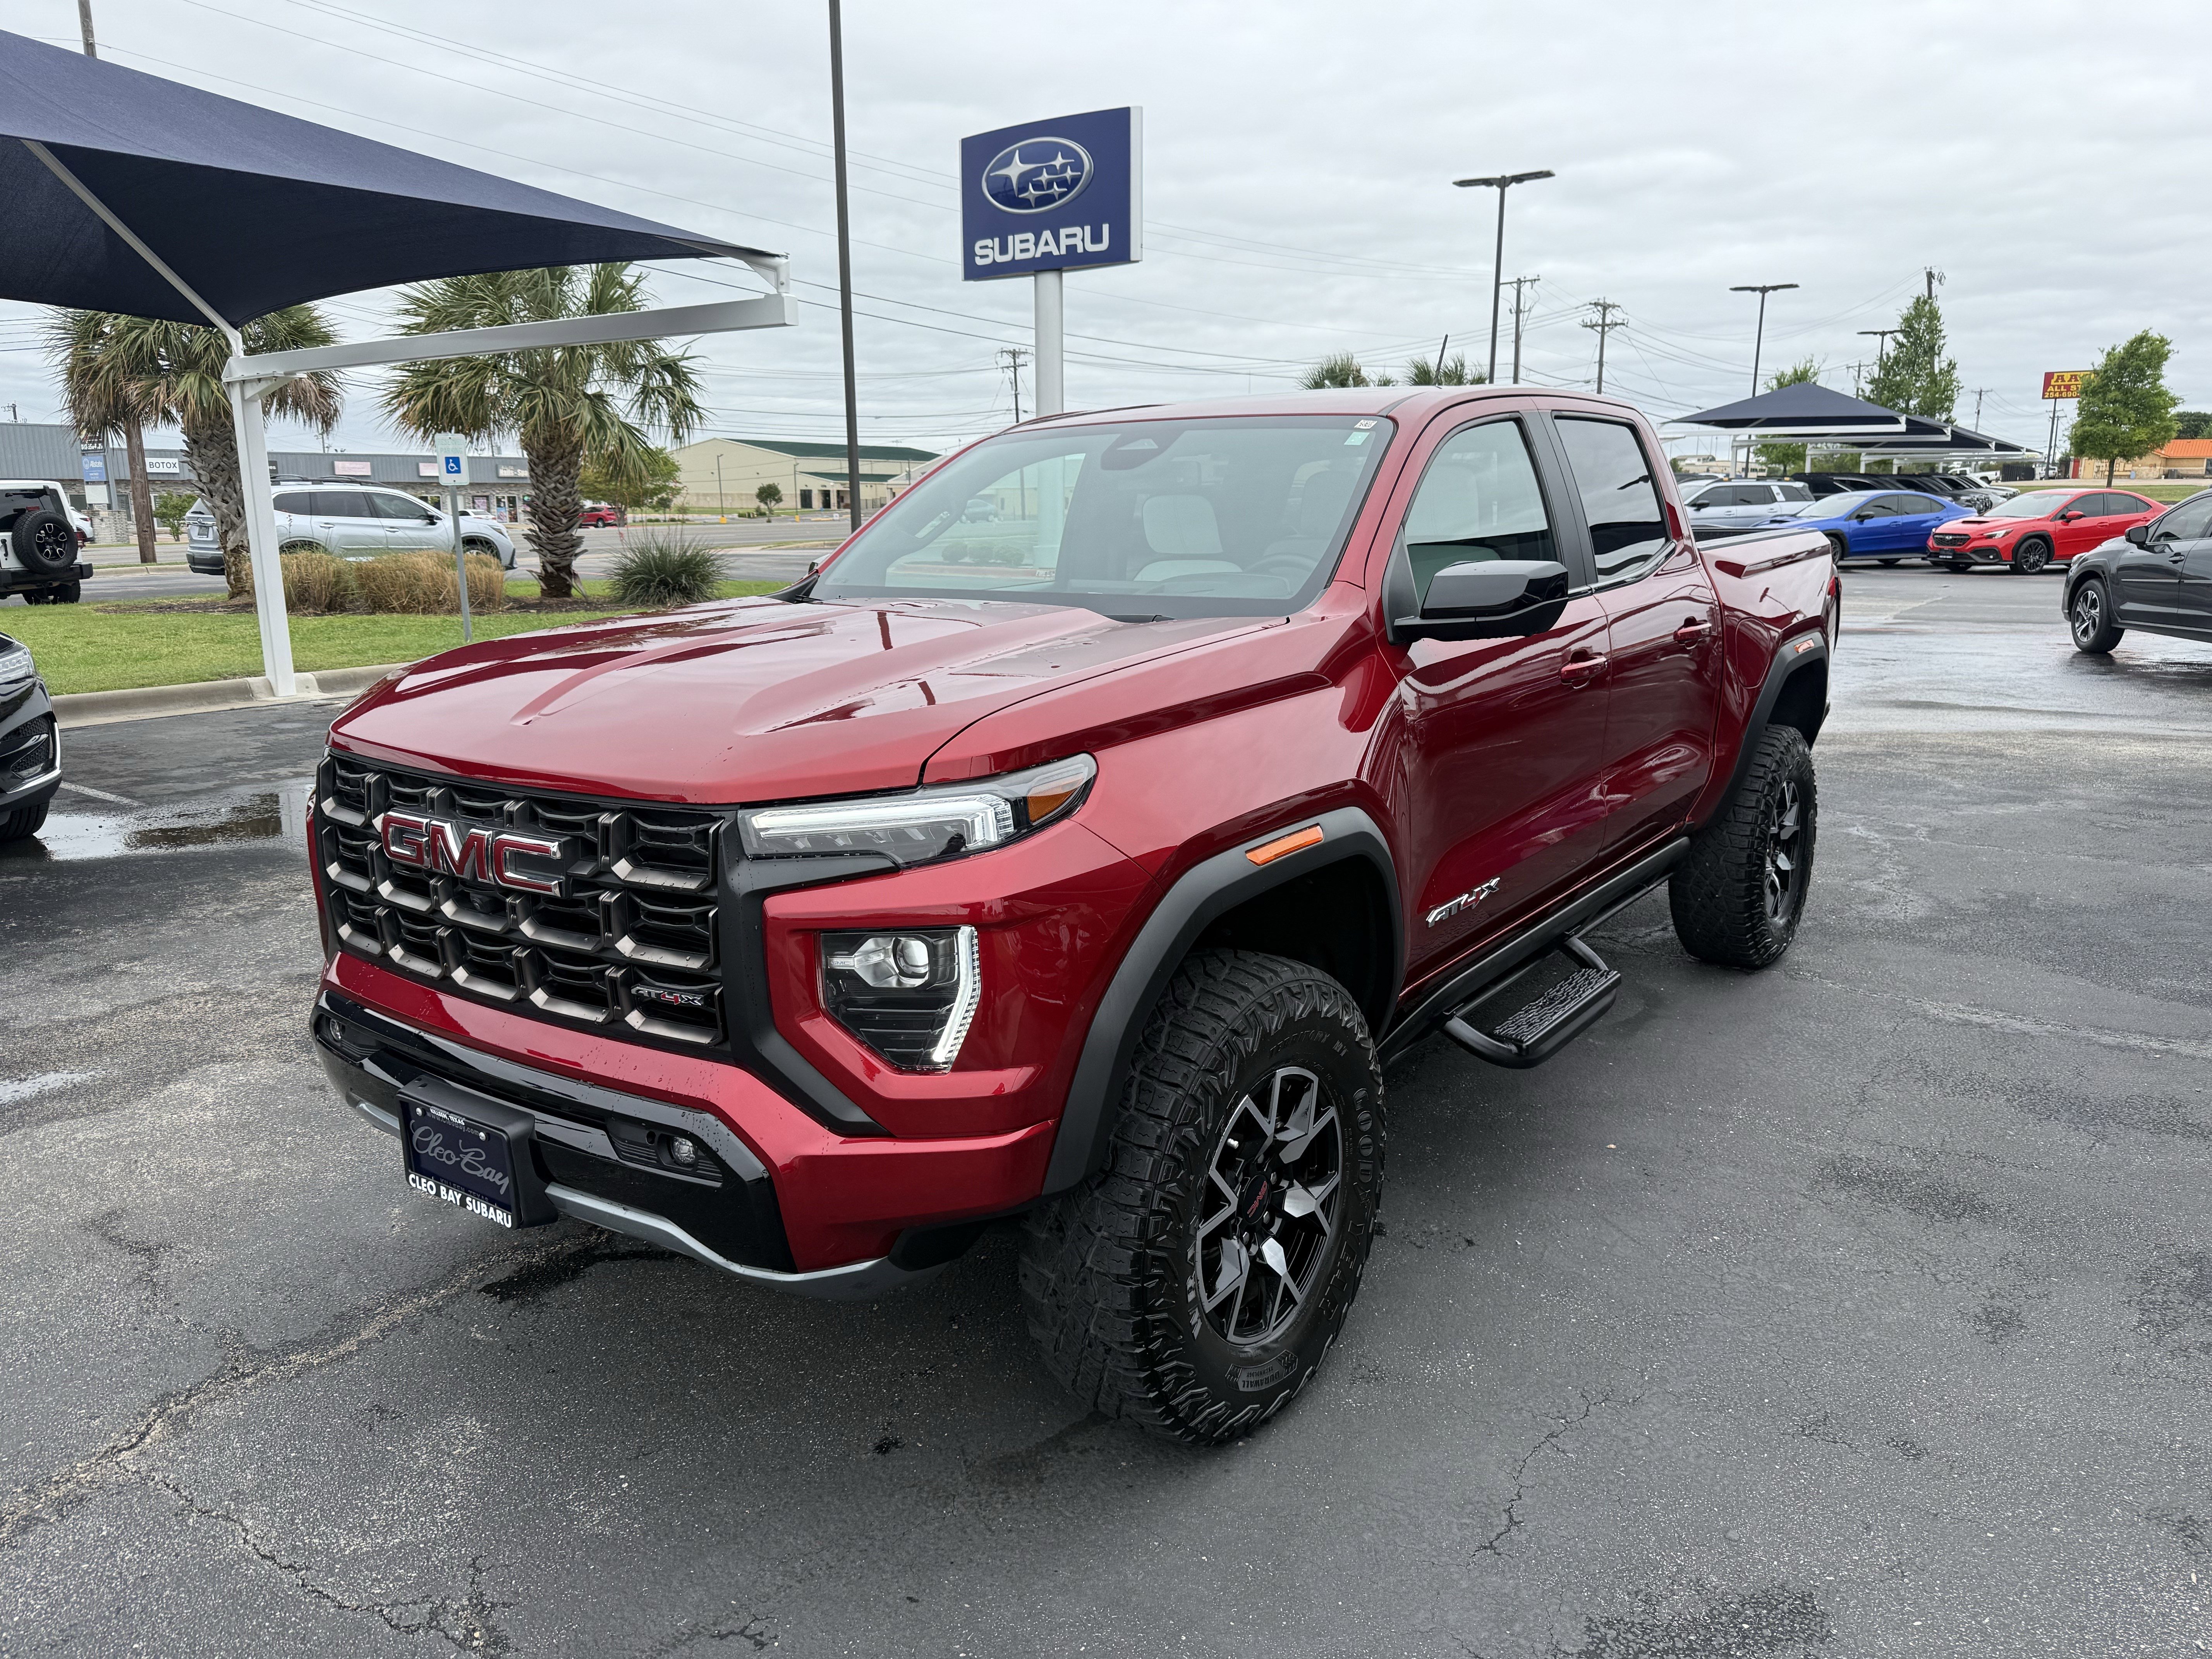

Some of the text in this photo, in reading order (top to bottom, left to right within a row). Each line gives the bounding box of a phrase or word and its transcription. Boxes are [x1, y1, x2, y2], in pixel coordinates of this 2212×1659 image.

[975, 224, 1109, 266] SUBARU
[381, 812, 564, 898] GMC
[1426, 877, 1500, 928] AT4X
[630, 986, 704, 1006] AT4X
[449, 1116, 465, 1125] TEXAS
[409, 1120, 509, 1195] Cleo Bay
[409, 1173, 512, 1228] CLEO BAY SUBARU
[1247, 1180, 1268, 1218] GMC
[1242, 1370, 1280, 1388] DURAWALL
[1246, 1365, 1273, 1378] TECHNOLOGY
